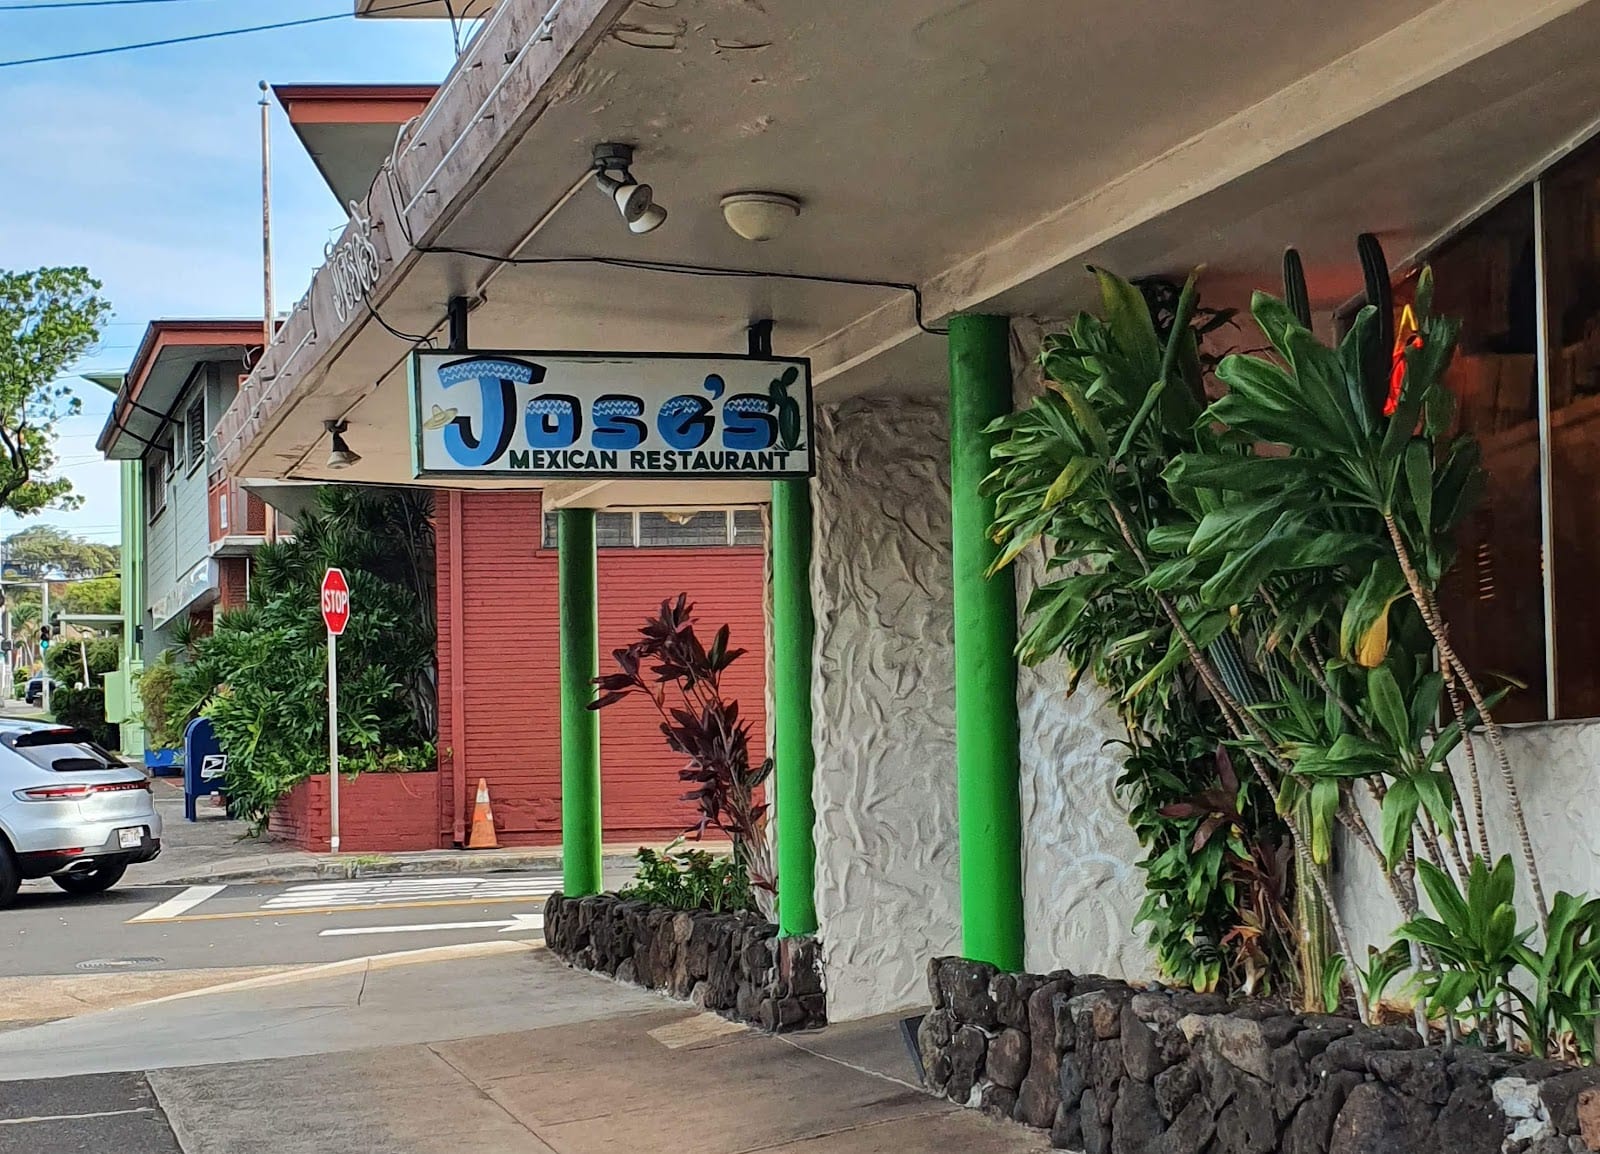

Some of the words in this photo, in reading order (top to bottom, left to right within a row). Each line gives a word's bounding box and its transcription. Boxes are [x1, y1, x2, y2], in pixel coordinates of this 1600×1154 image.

[437, 355, 779, 467] Jose's
[509, 449, 618, 470] MEXICAN
[630, 450, 790, 472] RESTAURANT
[324, 589, 347, 614] STOP
